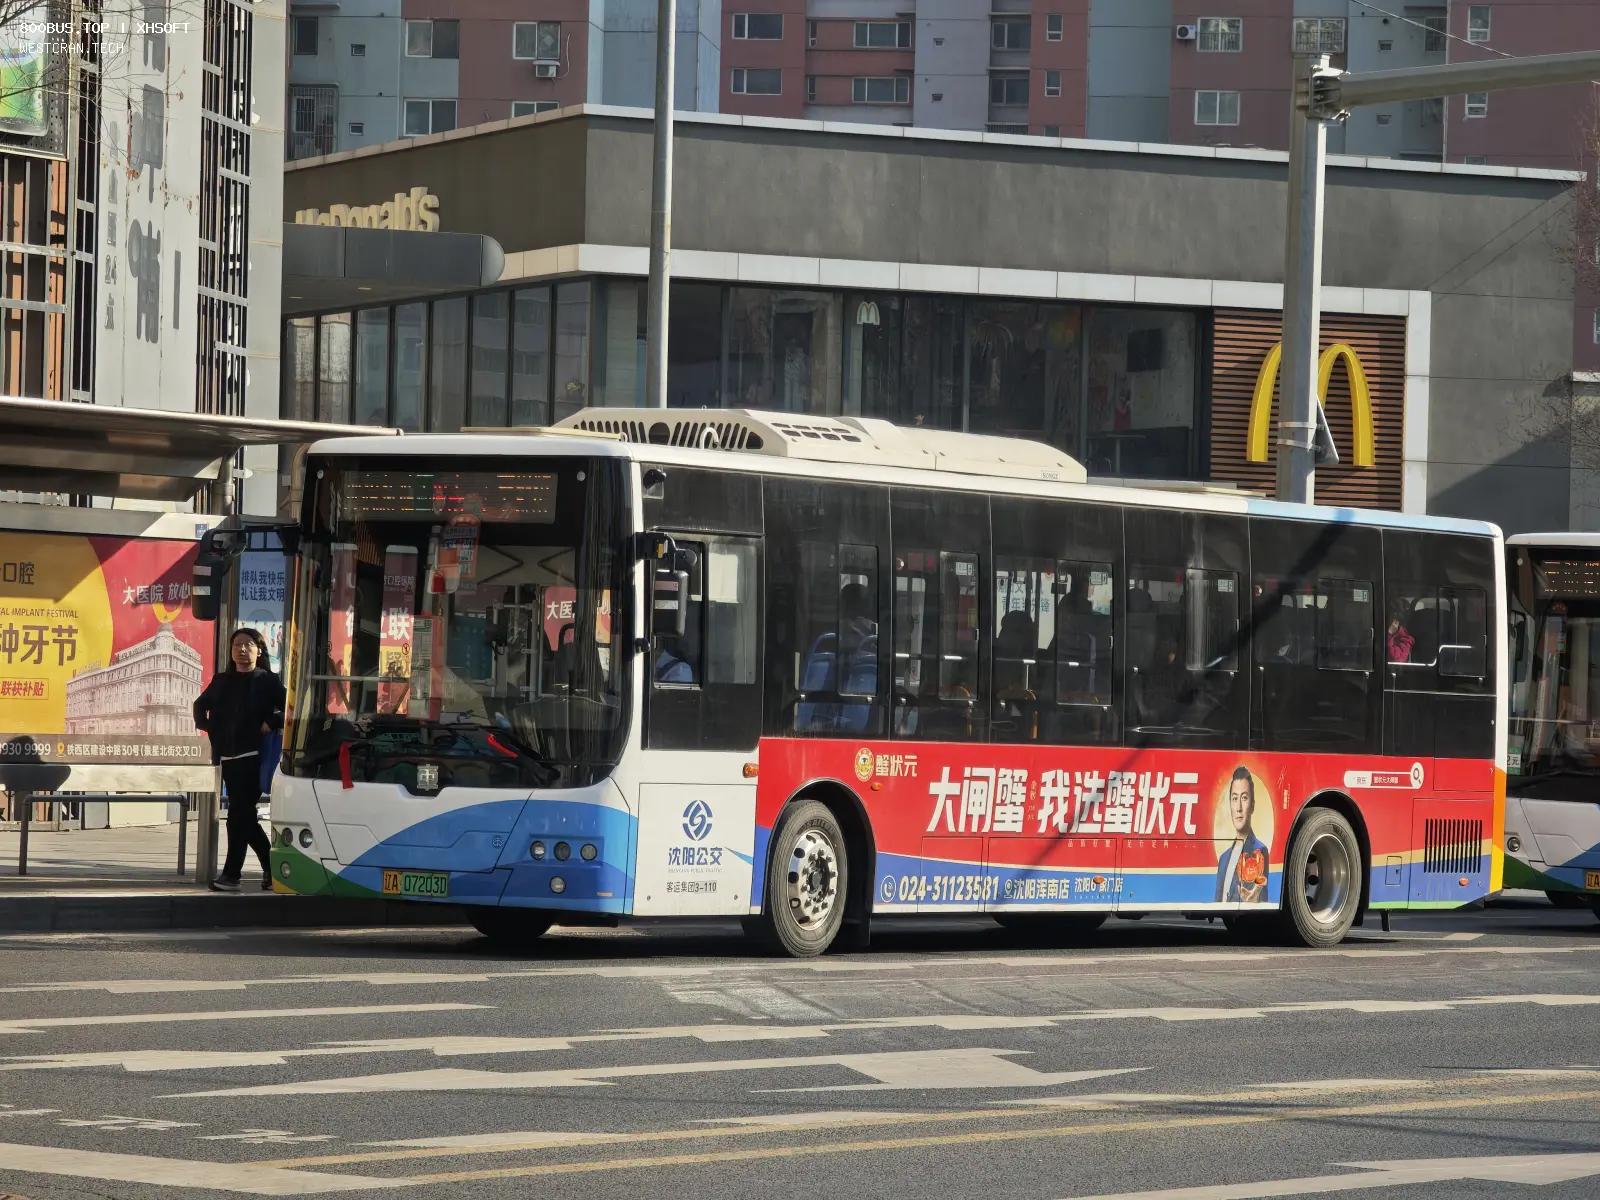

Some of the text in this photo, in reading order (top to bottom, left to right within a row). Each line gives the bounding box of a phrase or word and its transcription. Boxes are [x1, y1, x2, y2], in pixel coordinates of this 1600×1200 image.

[241, 569, 285, 585] 排队我快乐
[122, 585, 164, 605] 大医院
[240, 587, 285, 602] 礼让我文明
[0, 607, 79, 619] AL IMPLANT FESTIVAL
[546, 600, 577, 620] 大医
[0, 622, 79, 667] 种牙节
[24, 743, 51, 757] 9999
[875, 754, 918, 777] 蟹状元
[926, 766, 1028, 833] 大闸蟹
[1037, 769, 1199, 836] 我选蟹状元
[668, 846, 723, 866] 沈阳公交
[666, 881, 717, 893] 客运集团3-110
[899, 876, 1124, 901] 024-31123581 沈阳浑南店 沈阳6家门店
